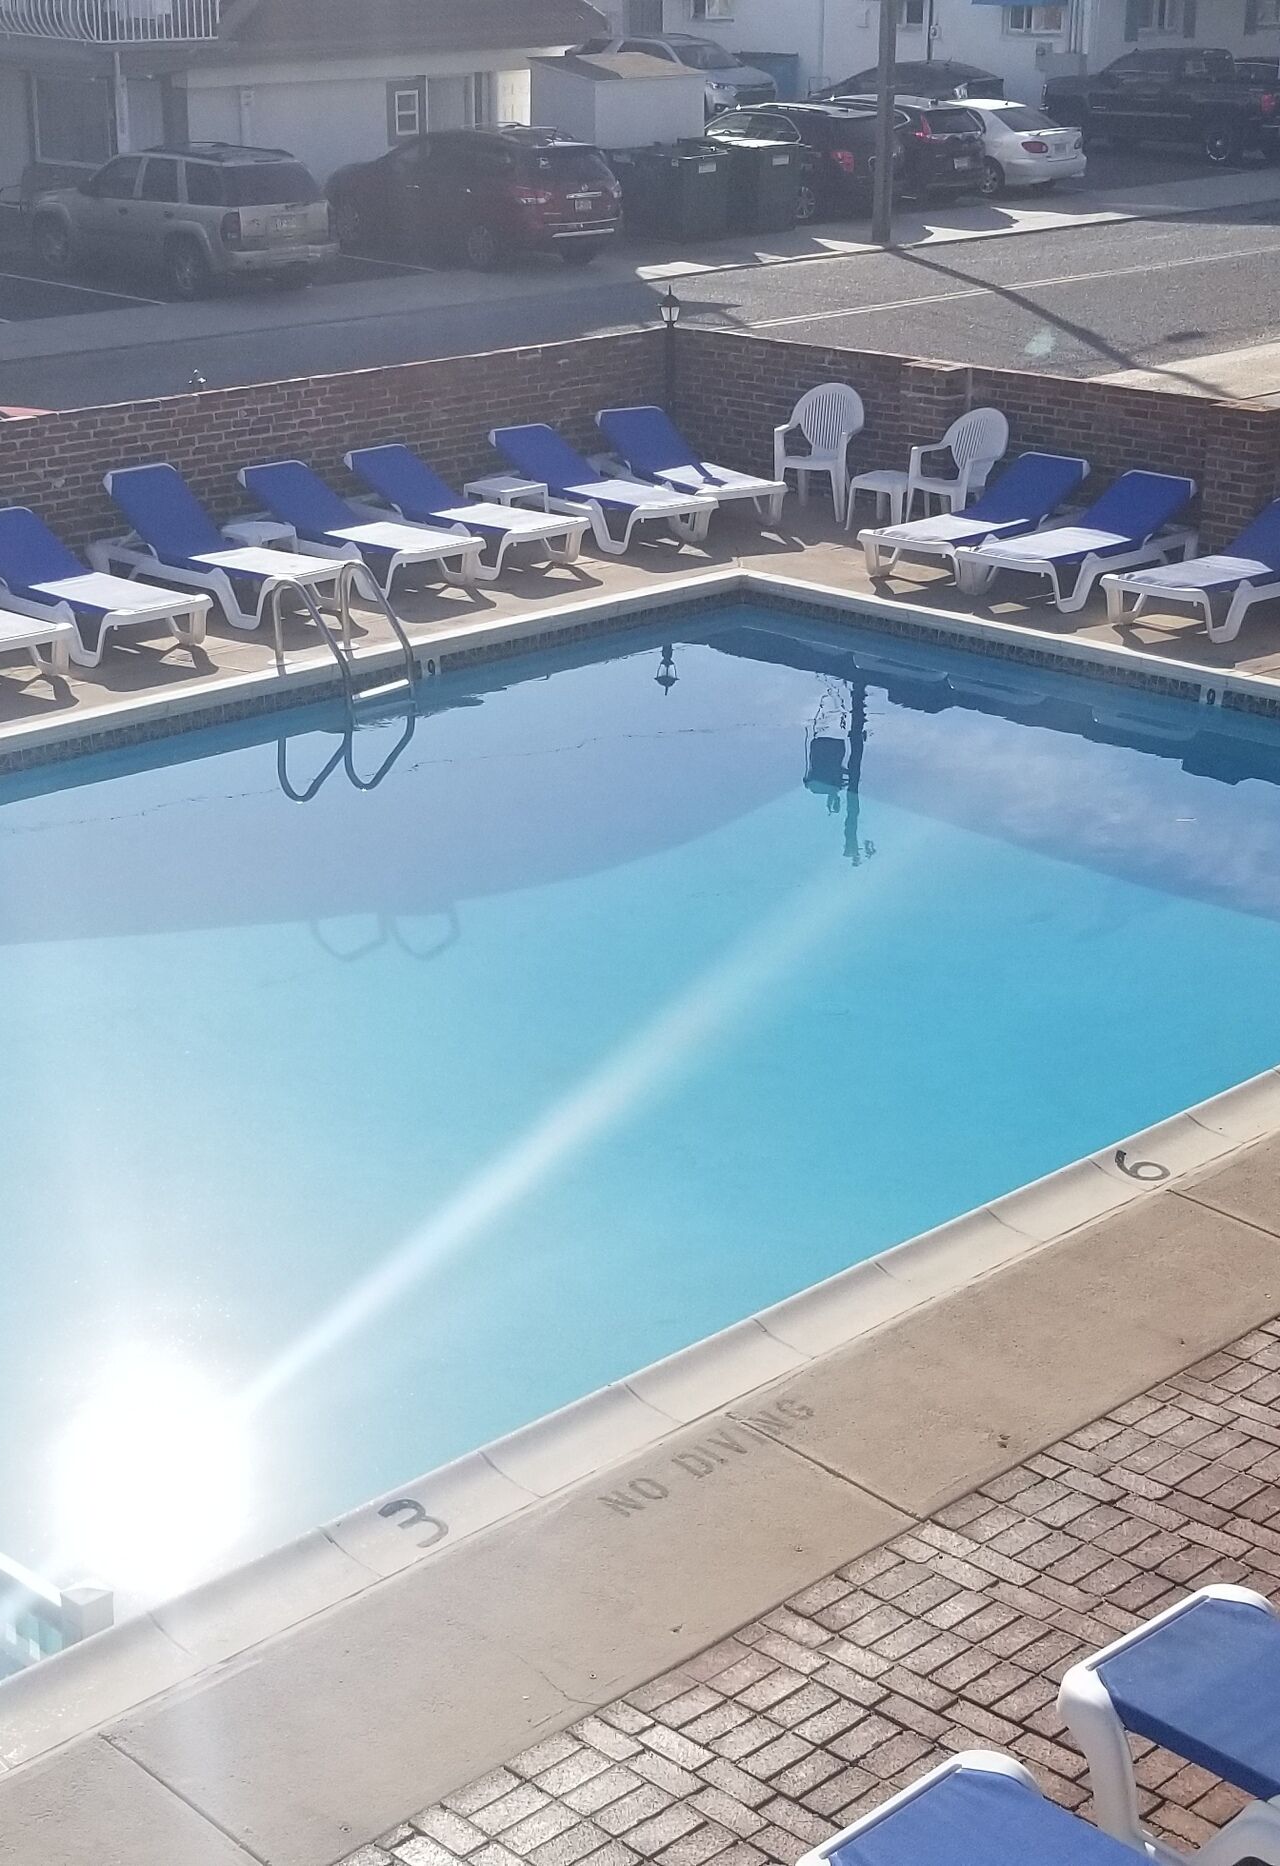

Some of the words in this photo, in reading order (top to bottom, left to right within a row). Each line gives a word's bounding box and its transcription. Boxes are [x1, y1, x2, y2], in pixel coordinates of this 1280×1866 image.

[1114, 1149, 1171, 1181] 6
[597, 1477, 670, 1518] NO
[671, 1399, 816, 1479] DIVING
[377, 1498, 449, 1549] 3
